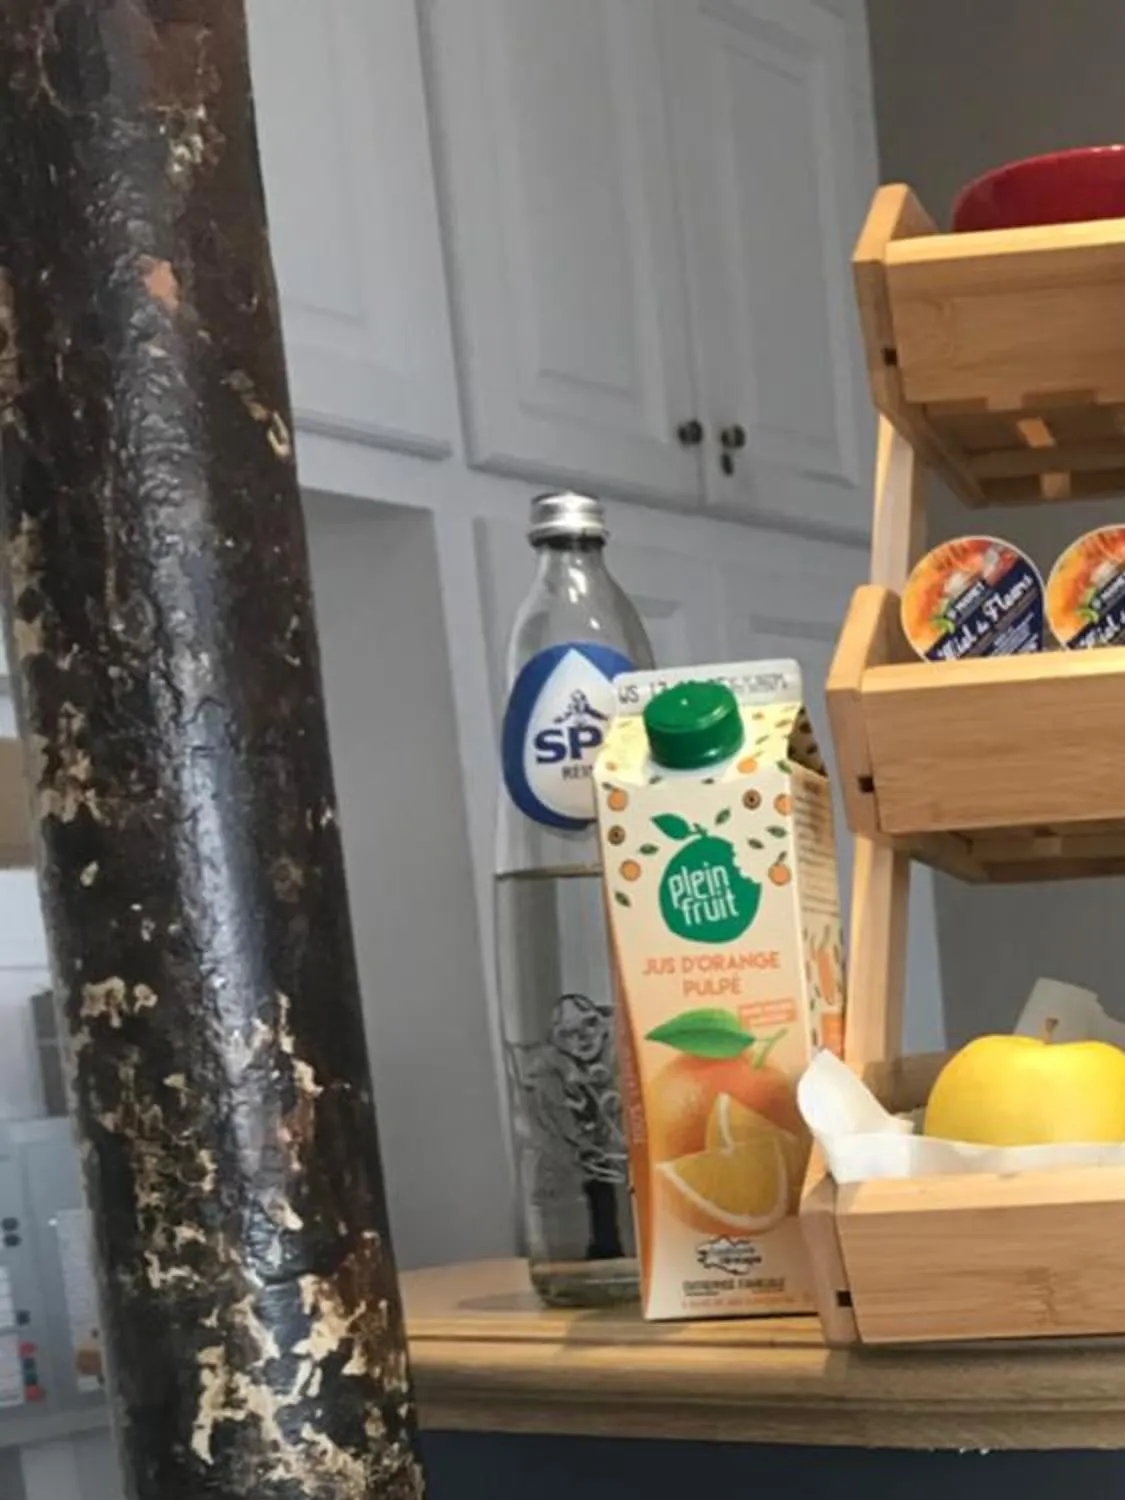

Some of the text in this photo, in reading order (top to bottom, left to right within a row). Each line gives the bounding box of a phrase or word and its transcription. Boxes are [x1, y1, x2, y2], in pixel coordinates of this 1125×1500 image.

[667, 861, 730, 910] plein
[681, 887, 740, 926] fruit
[642, 957, 676, 976] JUS
[681, 950, 781, 974] D'ORANGE
